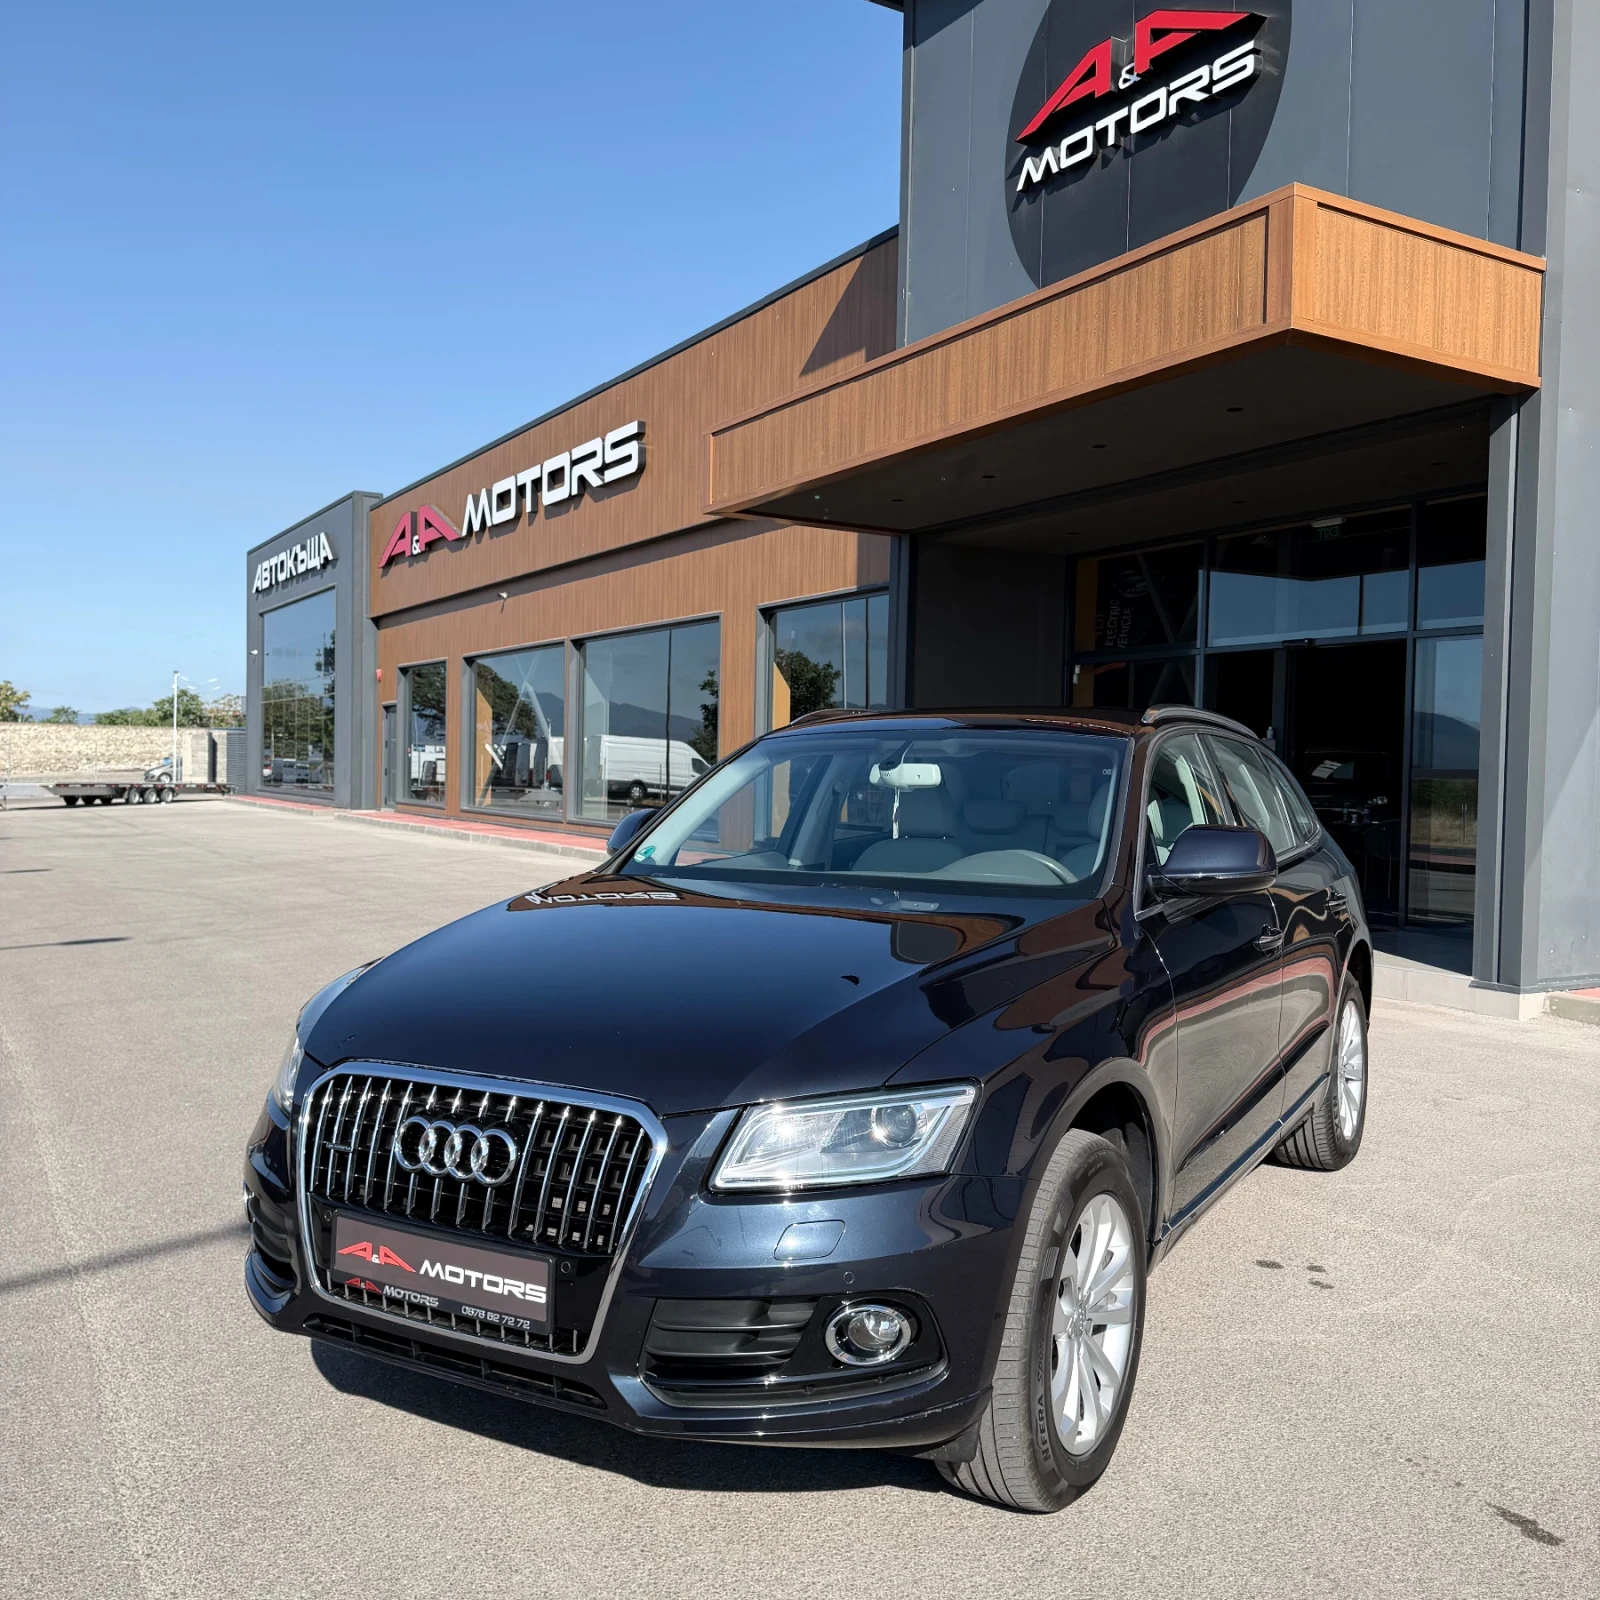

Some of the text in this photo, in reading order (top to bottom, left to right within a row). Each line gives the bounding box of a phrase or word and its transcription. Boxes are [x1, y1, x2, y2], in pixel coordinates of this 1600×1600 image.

[1016, 40, 1255, 192] MOTORS
[377, 420, 642, 569] A&A MOTORS
[252, 532, 334, 594] АВТОКЪЩА
[337, 1241, 547, 1304] A&A MOTORS
[345, 1277, 439, 1308] A&A MOTORS
[487, 1311, 500, 1322] 62
[502, 1315, 515, 1326] 72
[516, 1318, 530, 1330] 72
